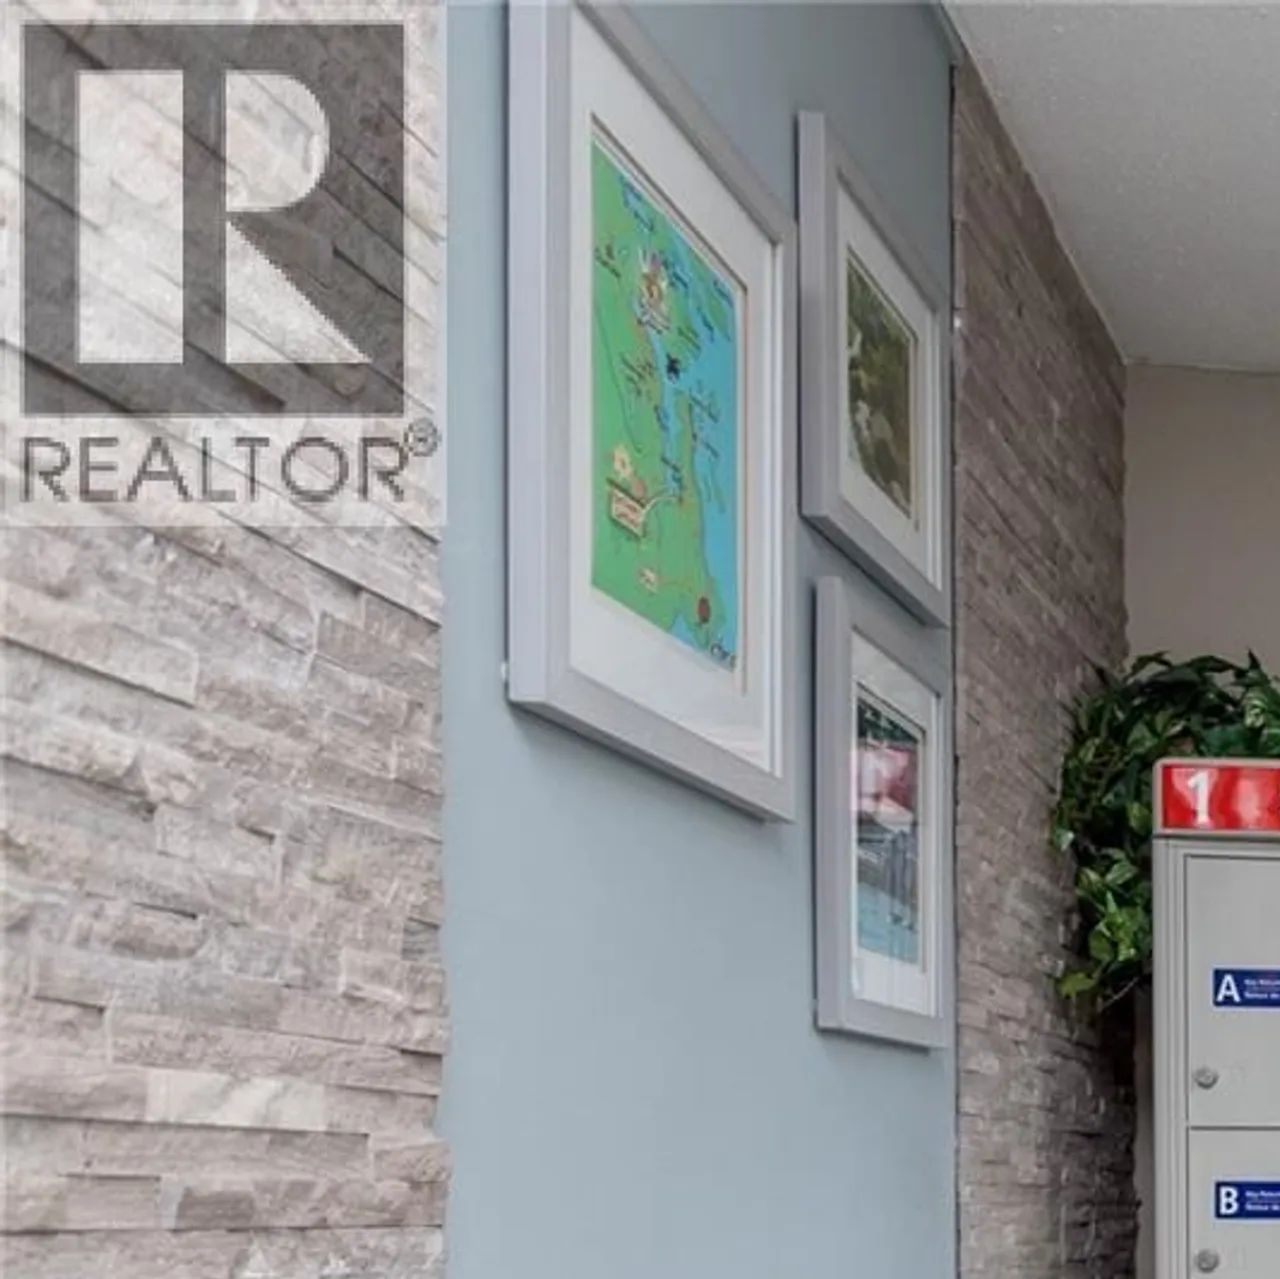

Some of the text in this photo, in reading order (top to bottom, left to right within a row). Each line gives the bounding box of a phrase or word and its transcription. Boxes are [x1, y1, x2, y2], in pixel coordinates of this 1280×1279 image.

[1187, 768, 1213, 827] 1
[1216, 973, 1242, 1003] A
[1219, 1185, 1239, 1215] B
